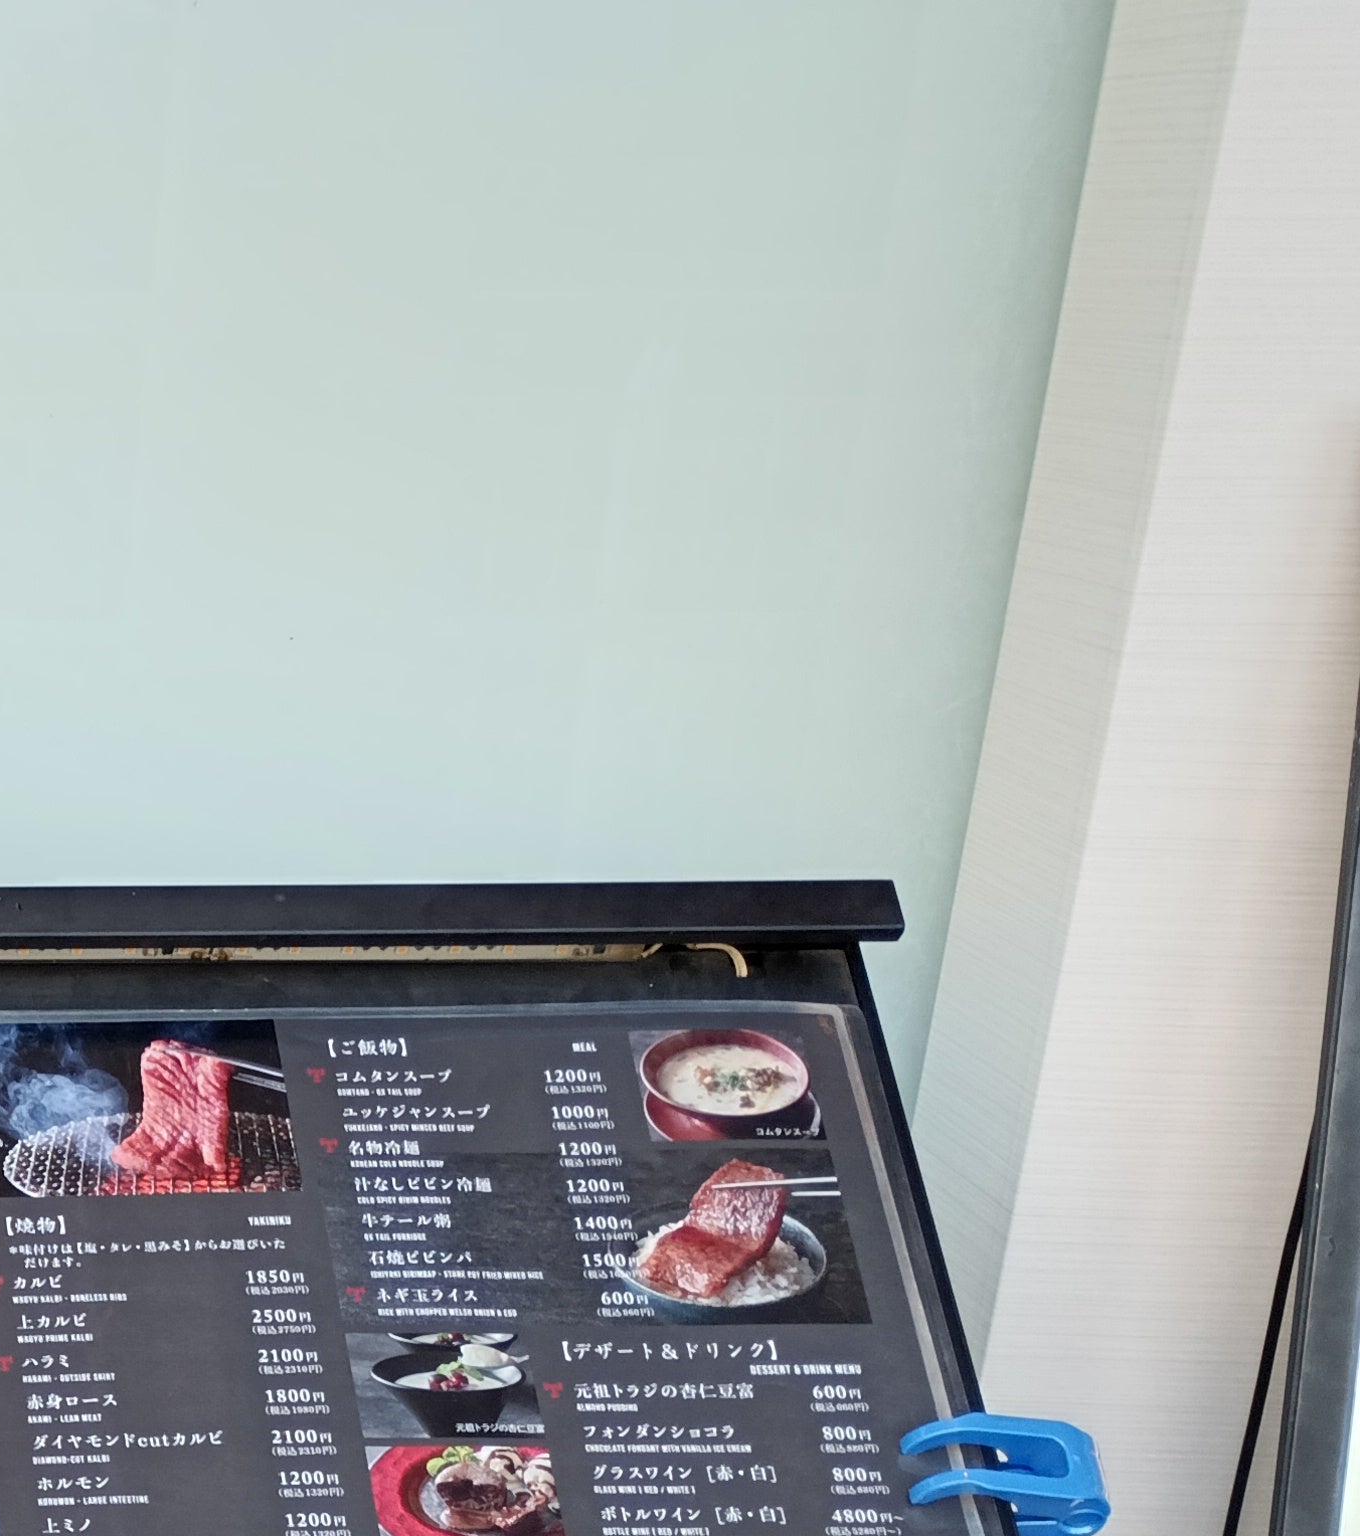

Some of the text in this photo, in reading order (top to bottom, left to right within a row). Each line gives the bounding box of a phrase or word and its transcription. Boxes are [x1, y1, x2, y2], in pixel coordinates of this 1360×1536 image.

[327, 1037, 408, 1058] 【ご飯物】
[335, 1068, 452, 1083] コムタンスープ
[543, 1068, 602, 1084] 1200円
[342, 1103, 491, 1119] ユッケジャンスープ
[348, 1139, 420, 1156] 名物冷麺
[558, 1141, 617, 1156] 1200円
[5, 1214, 66, 1237] 【焼物】
[361, 1212, 452, 1229] 牛テール粥
[574, 1215, 633, 1231] 1400円
[13, 1274, 63, 1290] カルビ
[600, 1288, 652, 1306] 600円
[17, 1312, 87, 1330] 上カルビ
[251, 1308, 312, 1324] 2500円
[21, 1354, 70, 1369] ハラミ
[258, 1348, 319, 1363] 2100円
[27, 1392, 118, 1410] 赤身ロース
[271, 1429, 332, 1445] 2100円
[583, 1423, 735, 1440] フォンダンショコラ
[821, 1425, 872, 1442] 800円
[37, 1476, 109, 1492] ホルモン
[42, 1517, 91, 1534] 上ミノ
[285, 1512, 347, 1528] 1200円
